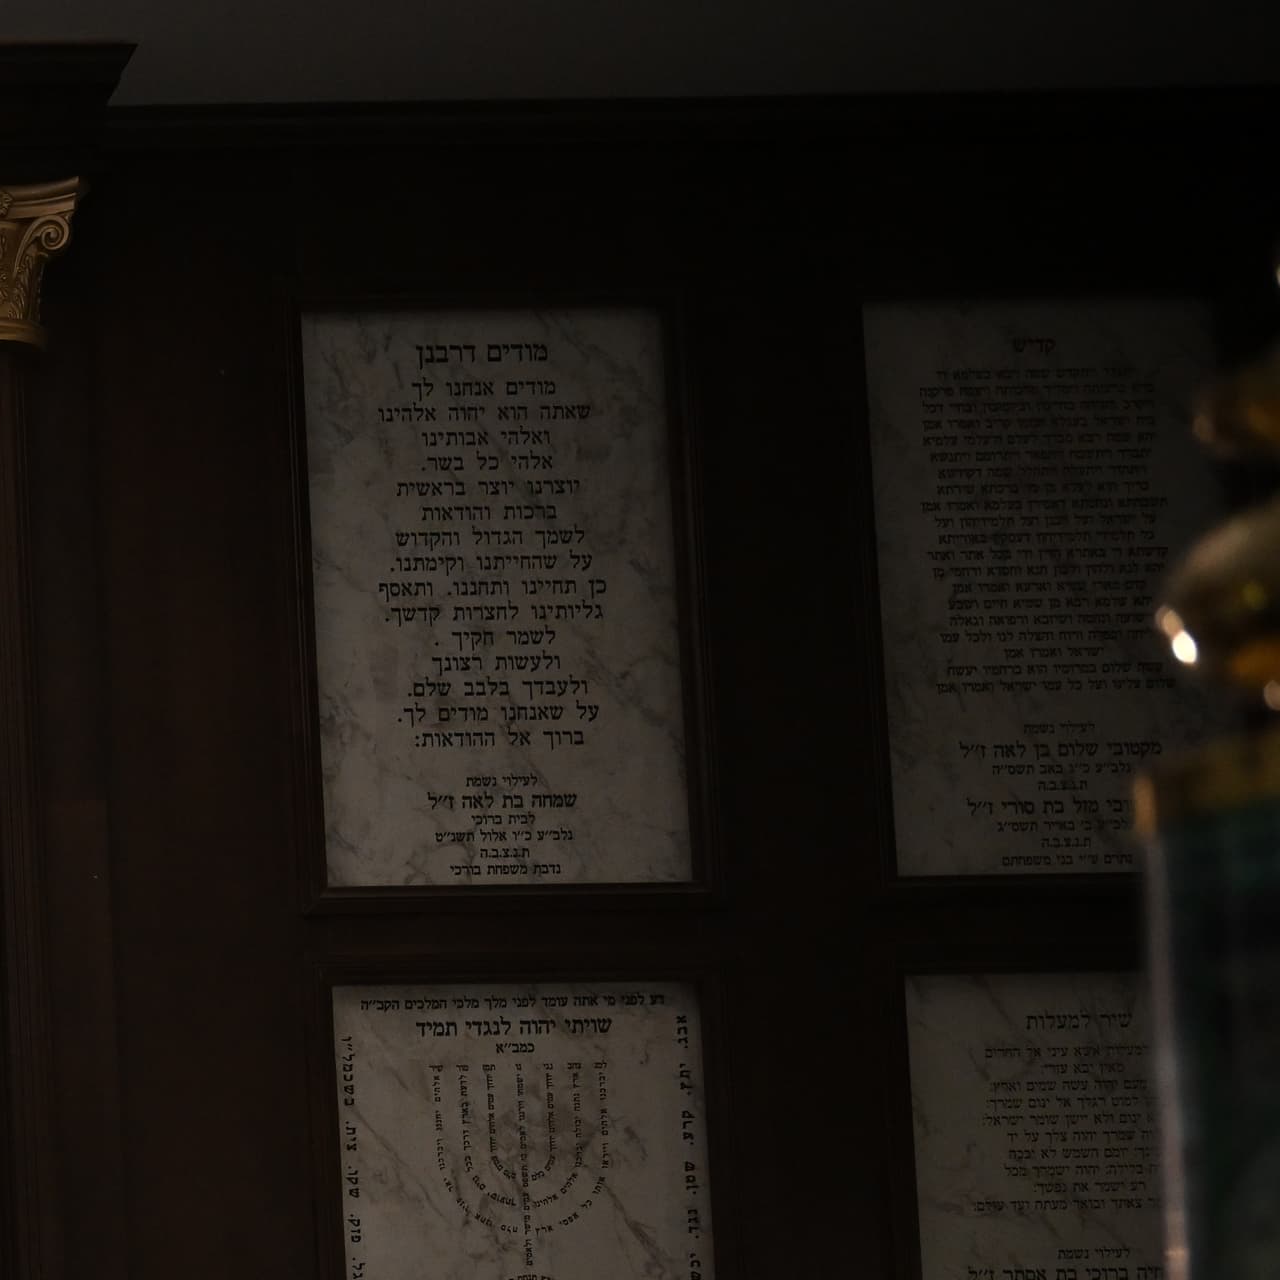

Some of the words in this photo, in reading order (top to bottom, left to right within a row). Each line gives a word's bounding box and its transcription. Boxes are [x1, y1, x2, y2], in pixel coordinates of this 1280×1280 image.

[415, 343, 477, 371] דרבנן
[487, 343, 549, 363] מודים
[378, 580, 434, 603] ותאסף
[520, 578, 577, 595] תחיינו
[587, 578, 607, 600] כן
[452, 599, 520, 622] לחצרות
[530, 598, 604, 621] גליותינו
[451, 628, 495, 652] חקיך
[505, 623, 556, 646] לשמר
[431, 653, 483, 678] רצונך
[494, 648, 561, 673] ולעשות
[463, 675, 512, 702] בלבב
[521, 673, 589, 701] ולעבדך
[437, 706, 489, 723] מודים
[500, 705, 564, 721] שאנחנו
[575, 699, 600, 723] על
[506, 727, 531, 748] אל
[542, 730, 585, 751] ברוך
[415, 1020, 458, 1038] תמיד
[464, 1015, 512, 1037] לנגדי
[519, 1018, 557, 1036] יהוה
[563, 1017, 613, 1035] שויתי
